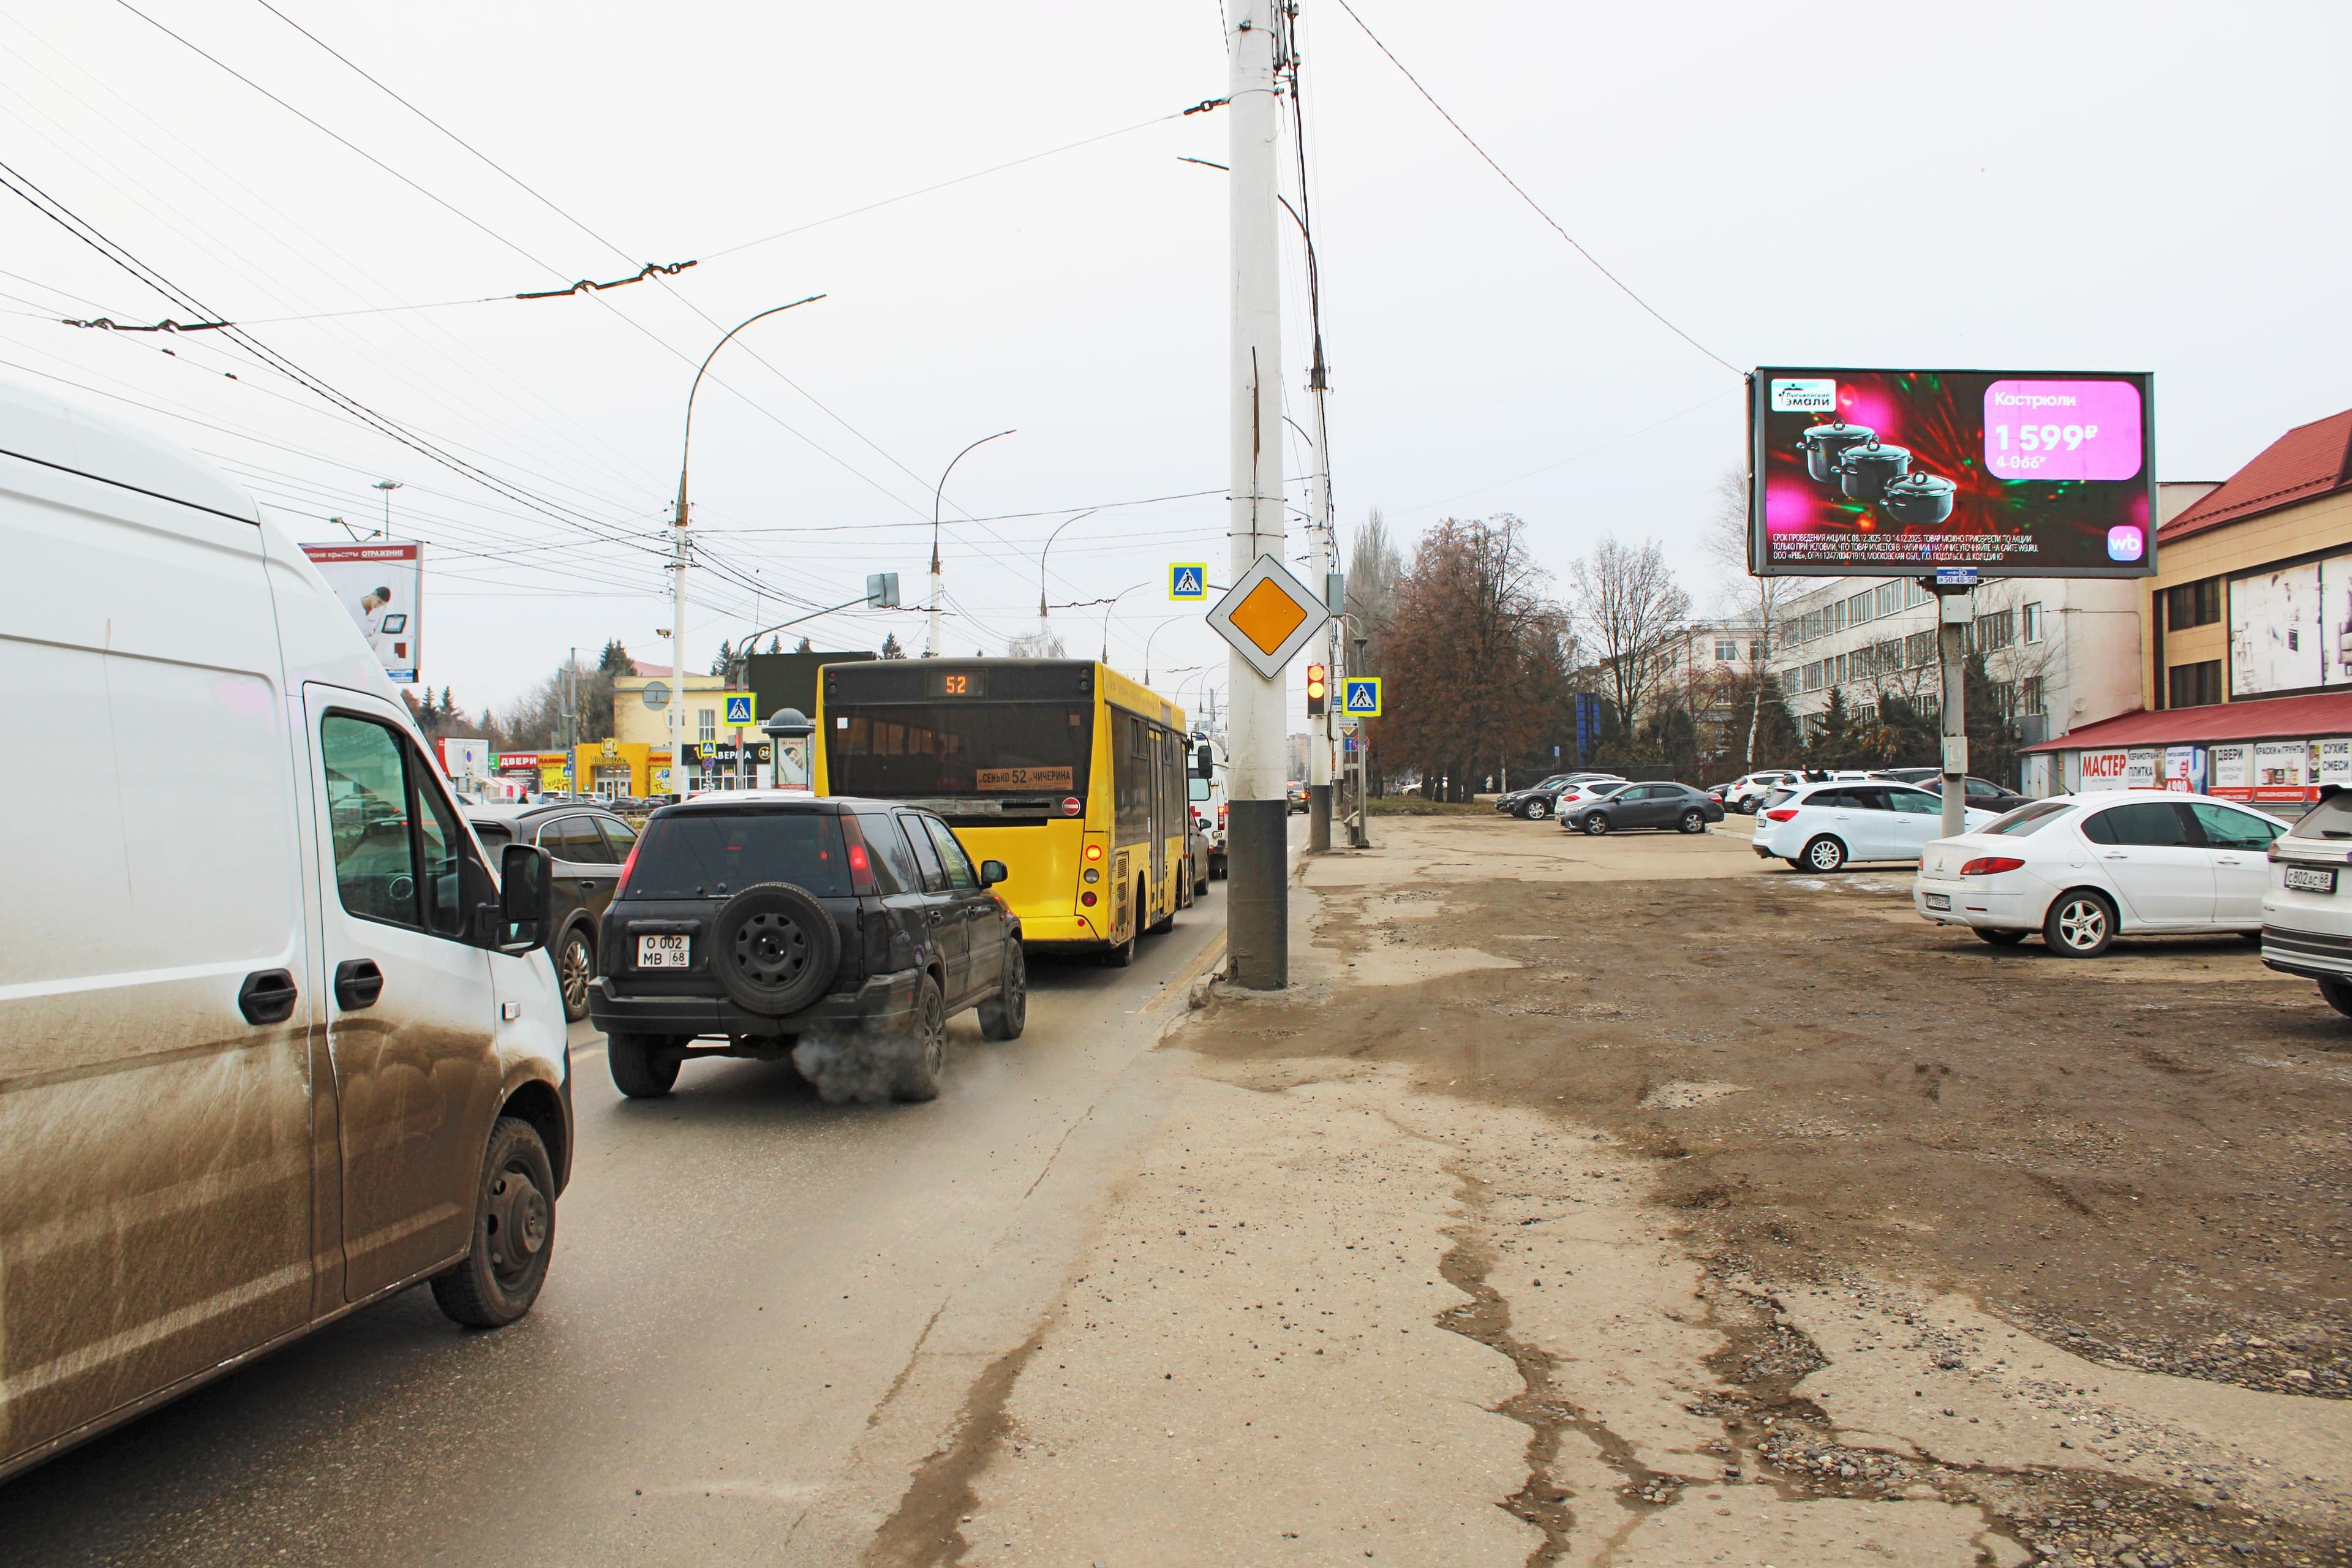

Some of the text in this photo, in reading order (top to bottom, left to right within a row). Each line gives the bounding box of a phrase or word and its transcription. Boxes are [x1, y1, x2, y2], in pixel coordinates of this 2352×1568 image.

[1995, 392, 2076, 409] Кастрюли
[1773, 533, 1788, 542] СРОК
[1789, 533, 1826, 543] ПРОВЕДЕНИЯ
[2111, 533, 2140, 551] wb
[361, 549, 404, 558] ОТРАЖЕНИЕ
[946, 676, 966, 694] 52
[2256, 746, 2277, 755] КРАСКИ
[2282, 745, 2305, 754] ГРУНТЫ
[2323, 743, 2348, 754] СУХИЕ
[2218, 748, 2243, 762] ДВЕРИ
[500, 757, 537, 767] ДВЕРИ
[2082, 754, 2127, 777] МАСТЕР
[2323, 760, 2348, 771] СМЕСИ
[982, 772, 1009, 783] СЕНЬКО
[1012, 770, 1027, 783] 52
[1033, 770, 1071, 782] ЧИЧЕРИНА
[2129, 766, 2153, 777] ПЛИТКА
[2320, 873, 2329, 884] 68
[660, 937, 682, 949] 002
[644, 952, 685, 965] МВ 68
